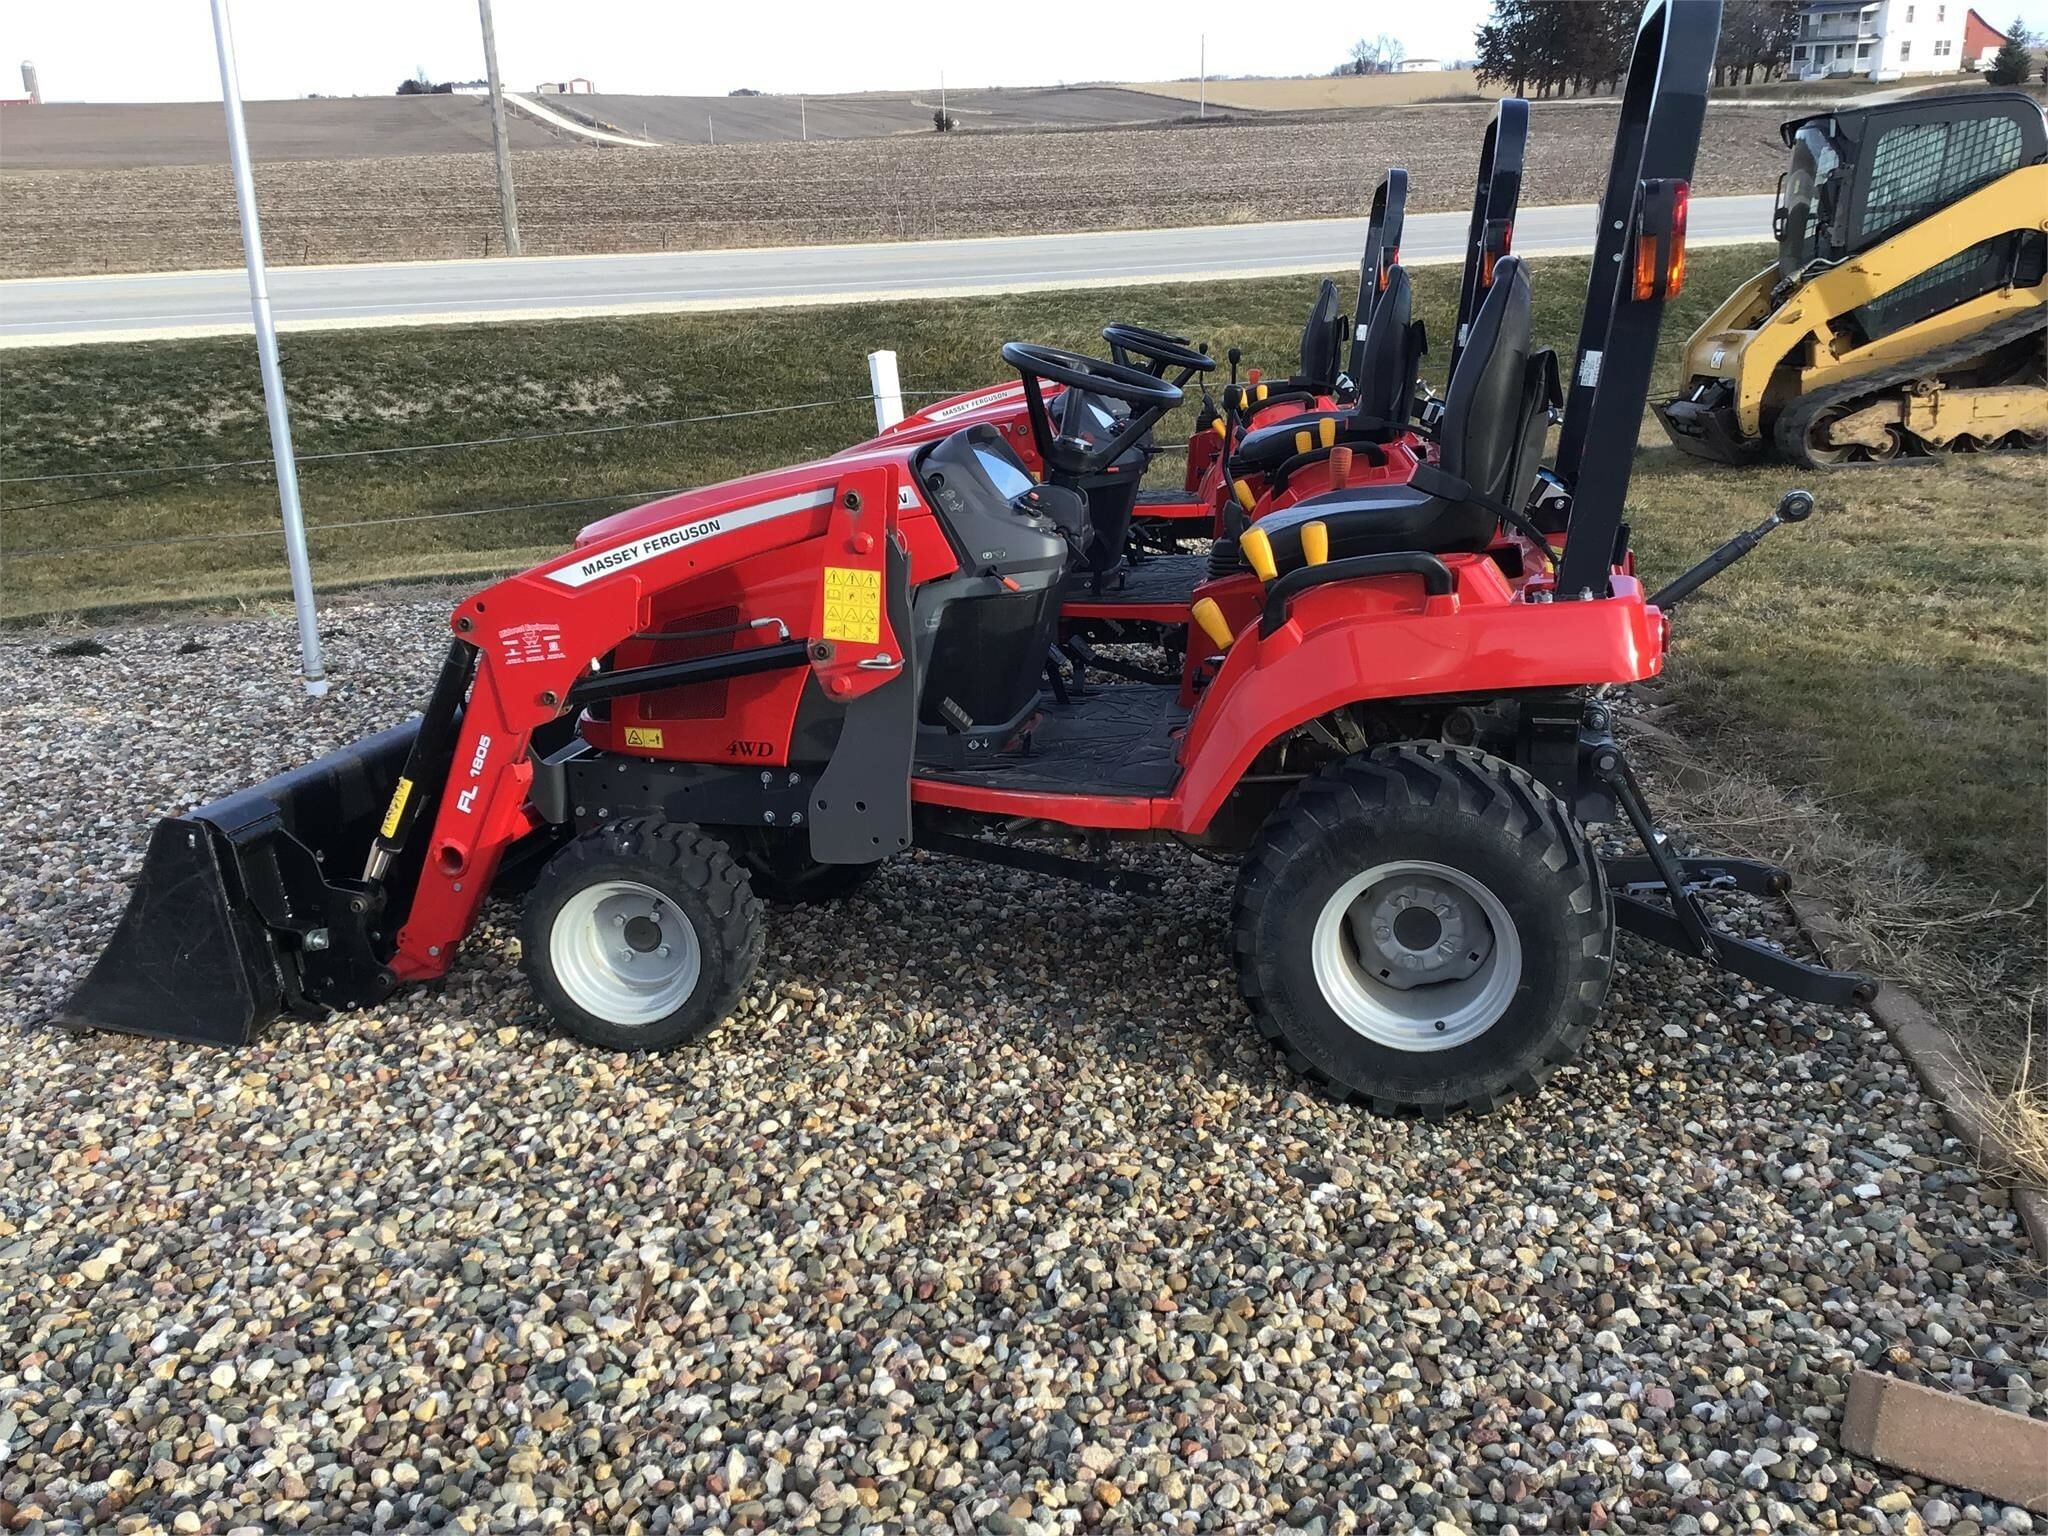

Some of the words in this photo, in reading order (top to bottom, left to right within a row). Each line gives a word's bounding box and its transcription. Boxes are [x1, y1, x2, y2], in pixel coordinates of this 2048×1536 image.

[942, 403, 970, 417] MASSEY
[971, 391, 1008, 407] FERGUSON
[582, 546, 638, 577] MASSEY
[643, 519, 721, 554] FERGUSON
[725, 739, 775, 758] 4WD
[456, 785, 479, 814] FL
[469, 734, 492, 778] 1805
